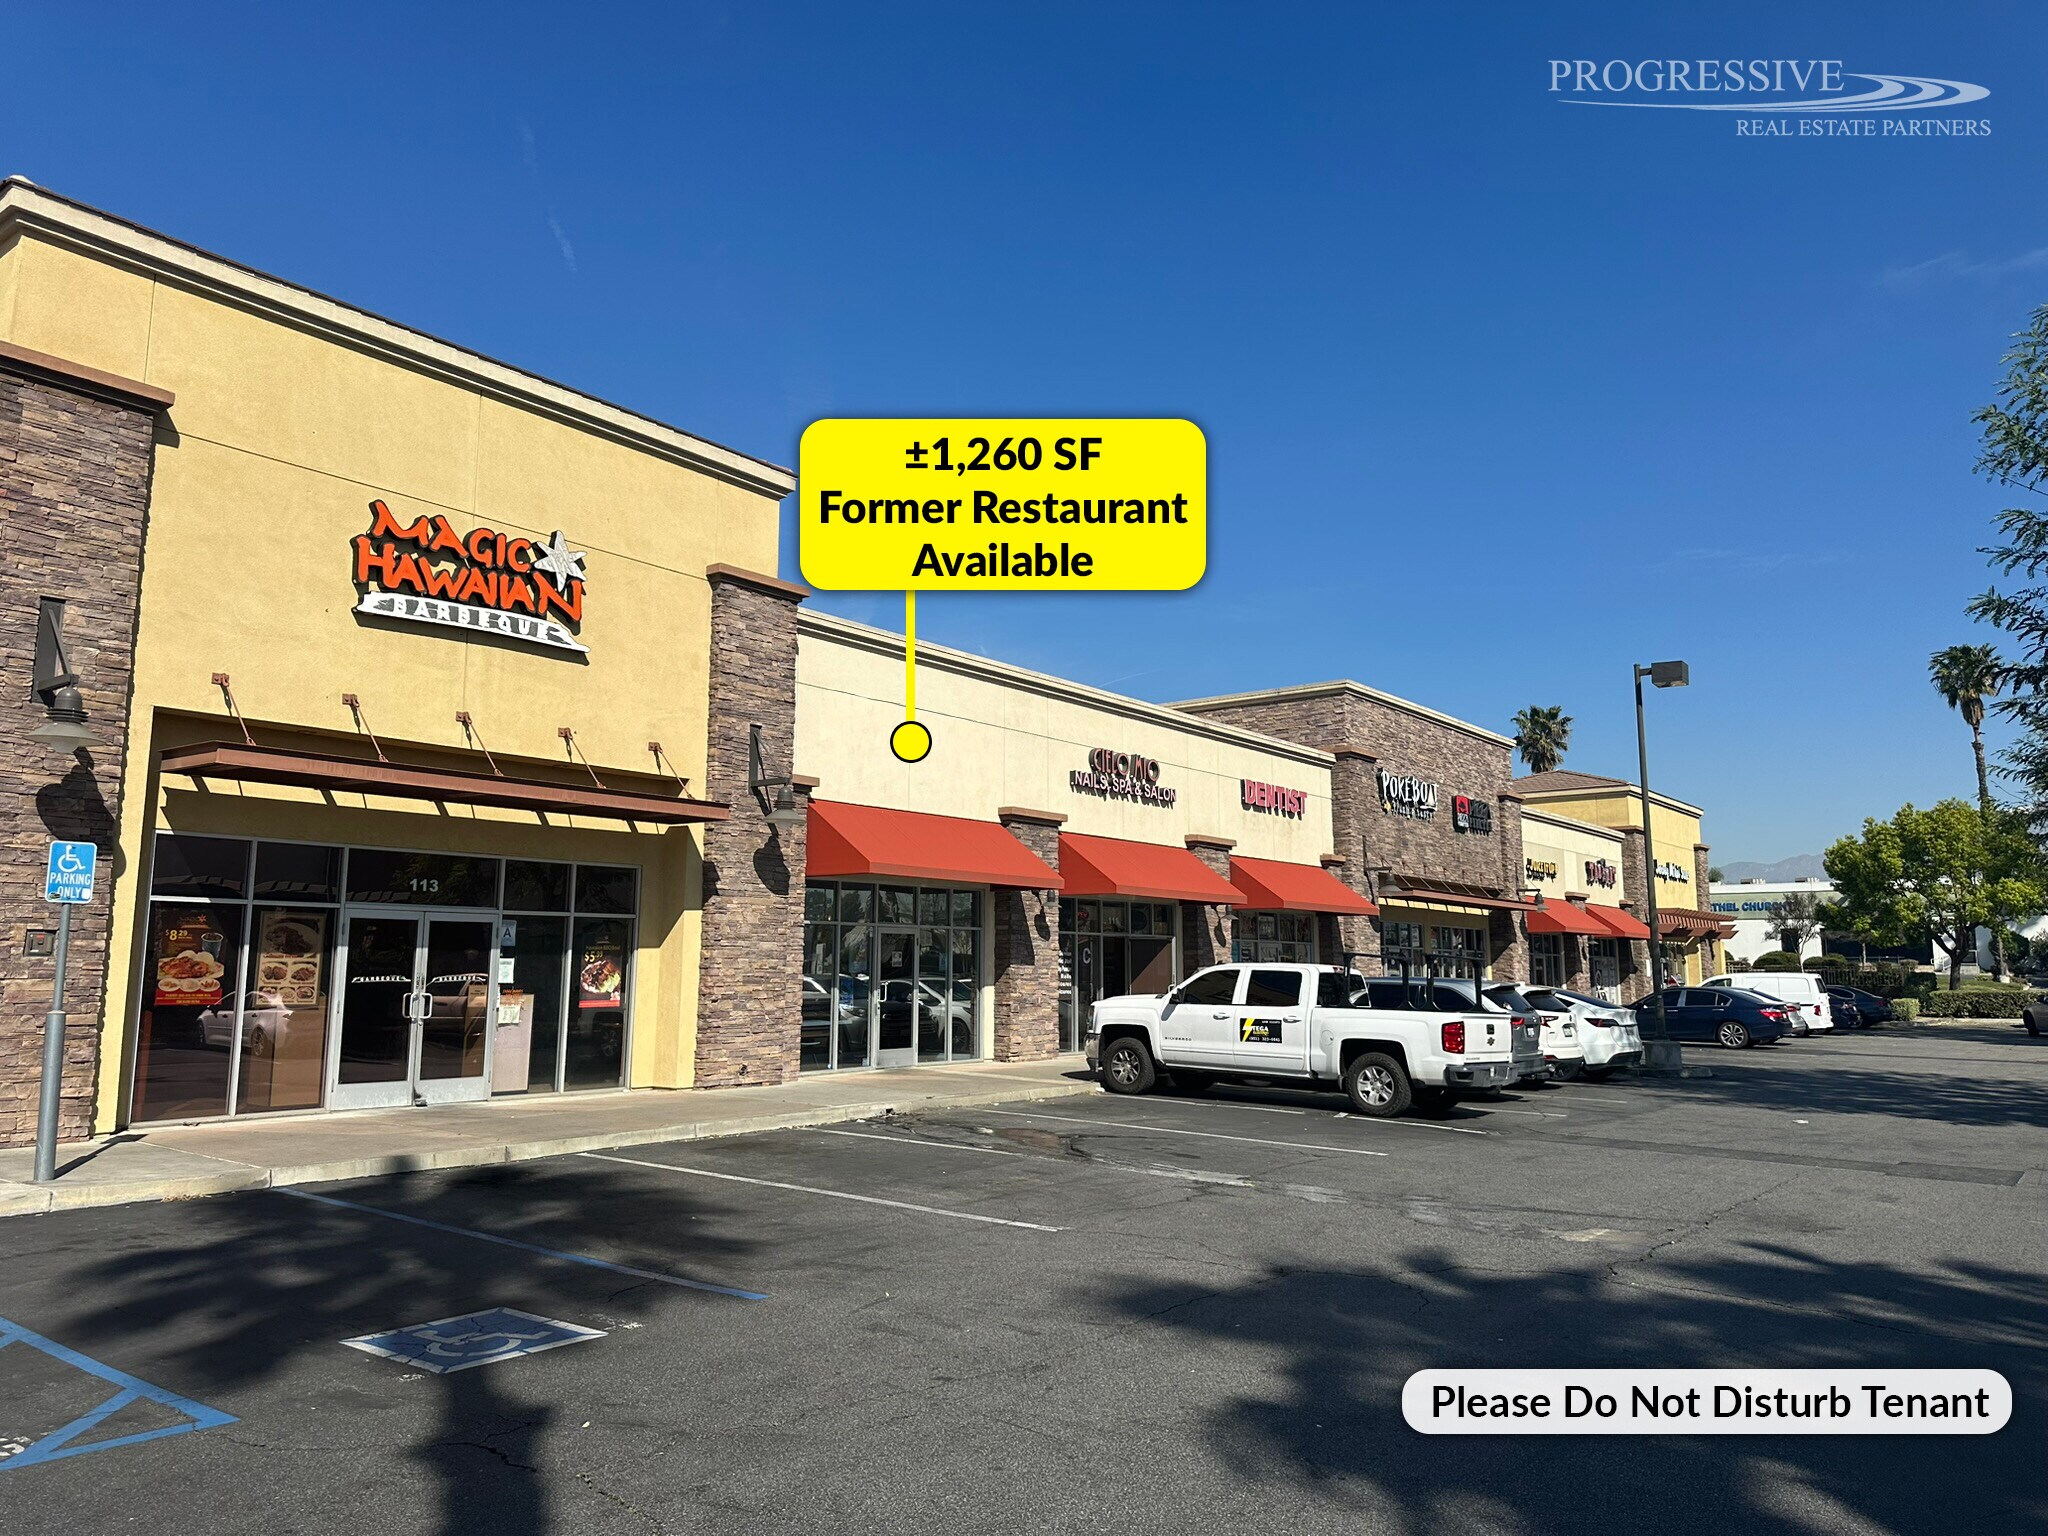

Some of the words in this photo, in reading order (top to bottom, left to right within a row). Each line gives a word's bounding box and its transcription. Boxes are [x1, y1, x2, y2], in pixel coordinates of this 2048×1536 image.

[370, 499, 532, 574] MAGIC
[355, 535, 583, 623] HAWAIIAN
[392, 597, 554, 641] BARBEQUE
[1091, 748, 1129, 775] CIELO
[1133, 756, 1160, 781] MIO
[1112, 778, 1133, 795] SPA
[1134, 782, 1143, 795] &
[1144, 783, 1176, 801] SALON
[1244, 779, 1307, 814] DENTIST
[50, 872, 91, 886] PARKING
[57, 886, 82, 899] ONLY
[409, 879, 439, 892] 113
[503, 927, 511, 938] A
